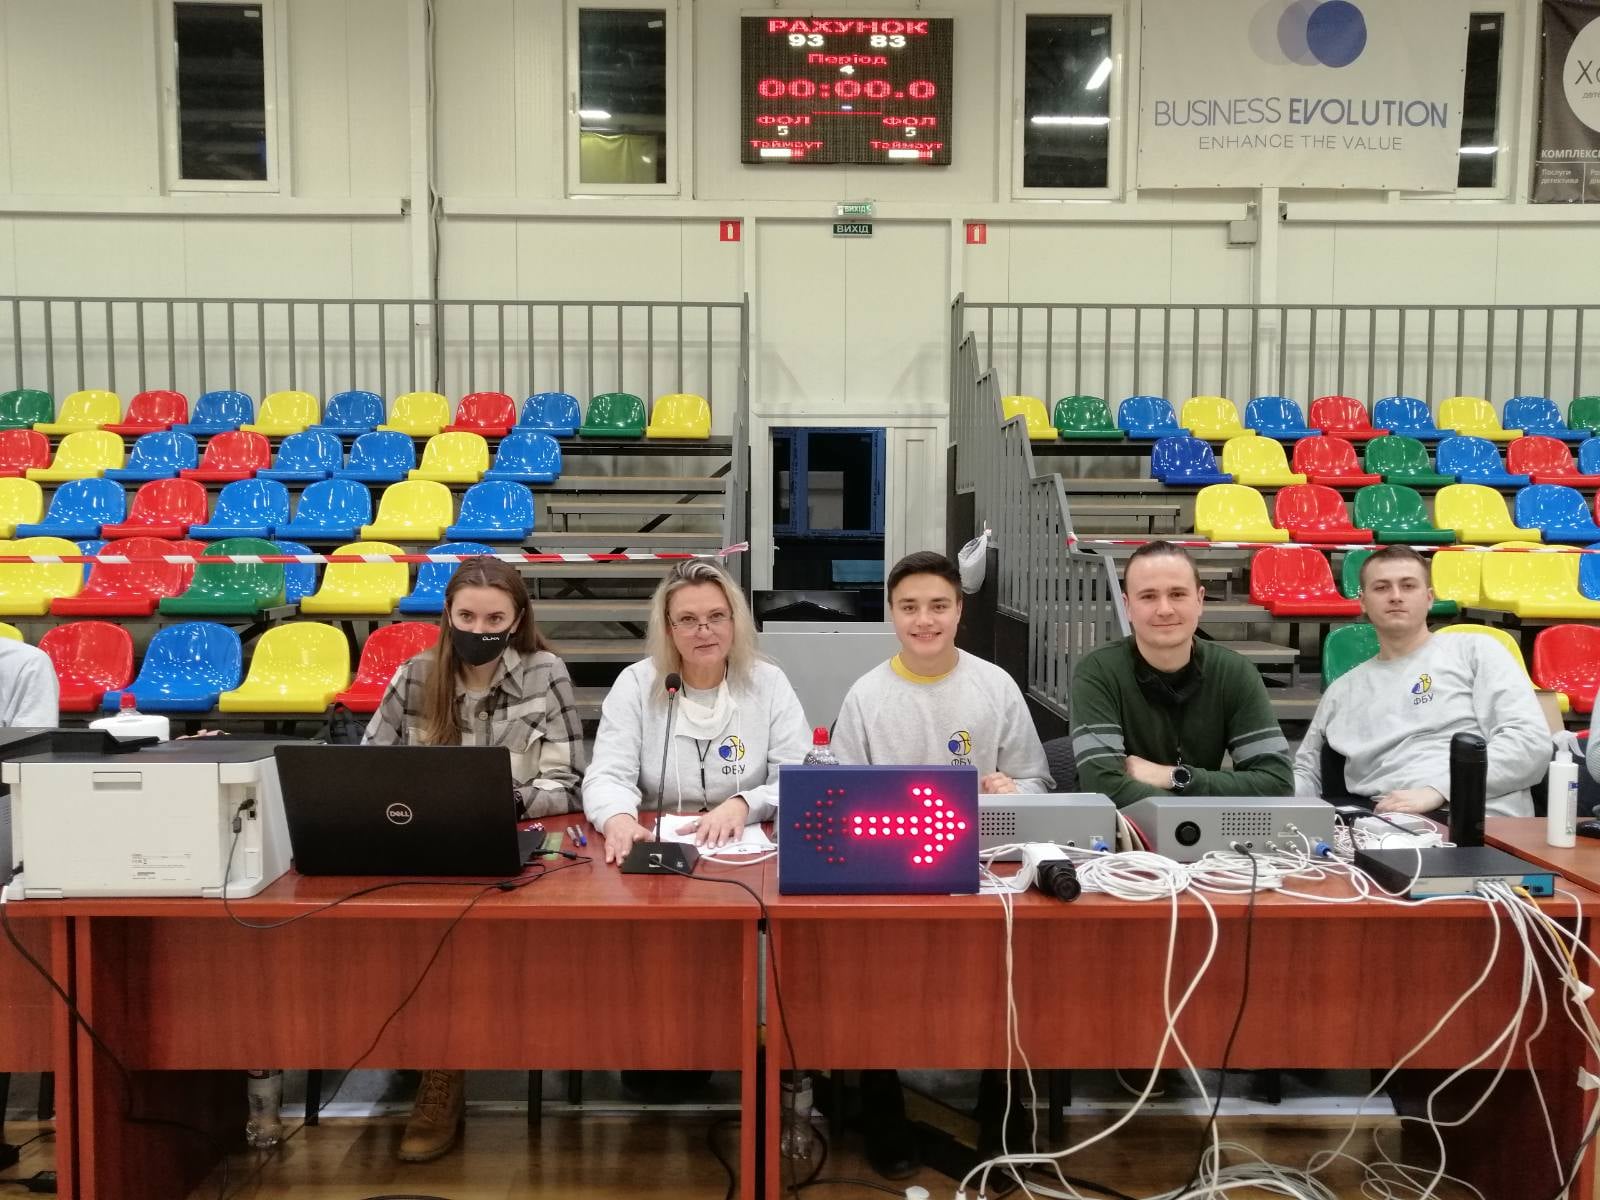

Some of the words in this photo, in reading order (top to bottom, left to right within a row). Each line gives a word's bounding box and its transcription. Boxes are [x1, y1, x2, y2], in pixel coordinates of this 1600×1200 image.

[768, 20, 928, 34] РАХУНОК
[788, 34, 824, 47] 93
[870, 35, 906, 48] 83
[808, 53, 887, 65] Період
[839, 65, 855, 75] 4
[758, 79, 936, 99] 00:00.0
[1154, 97, 1282, 127] BUSINESS
[1289, 97, 1449, 128] EVOLUTION
[756, 115, 811, 125] ФОЛ
[882, 116, 937, 127] ФОЛ
[777, 125, 789, 136] 5
[905, 126, 917, 137] 5
[1199, 134, 1294, 150] ENHANCE
[1300, 135, 1337, 149] THE
[1342, 135, 1403, 151] VALUE
[844, 205, 866, 213] ВИХІД
[836, 224, 869, 233] ВИХІД
[1413, 693, 1434, 705] ФБУ
